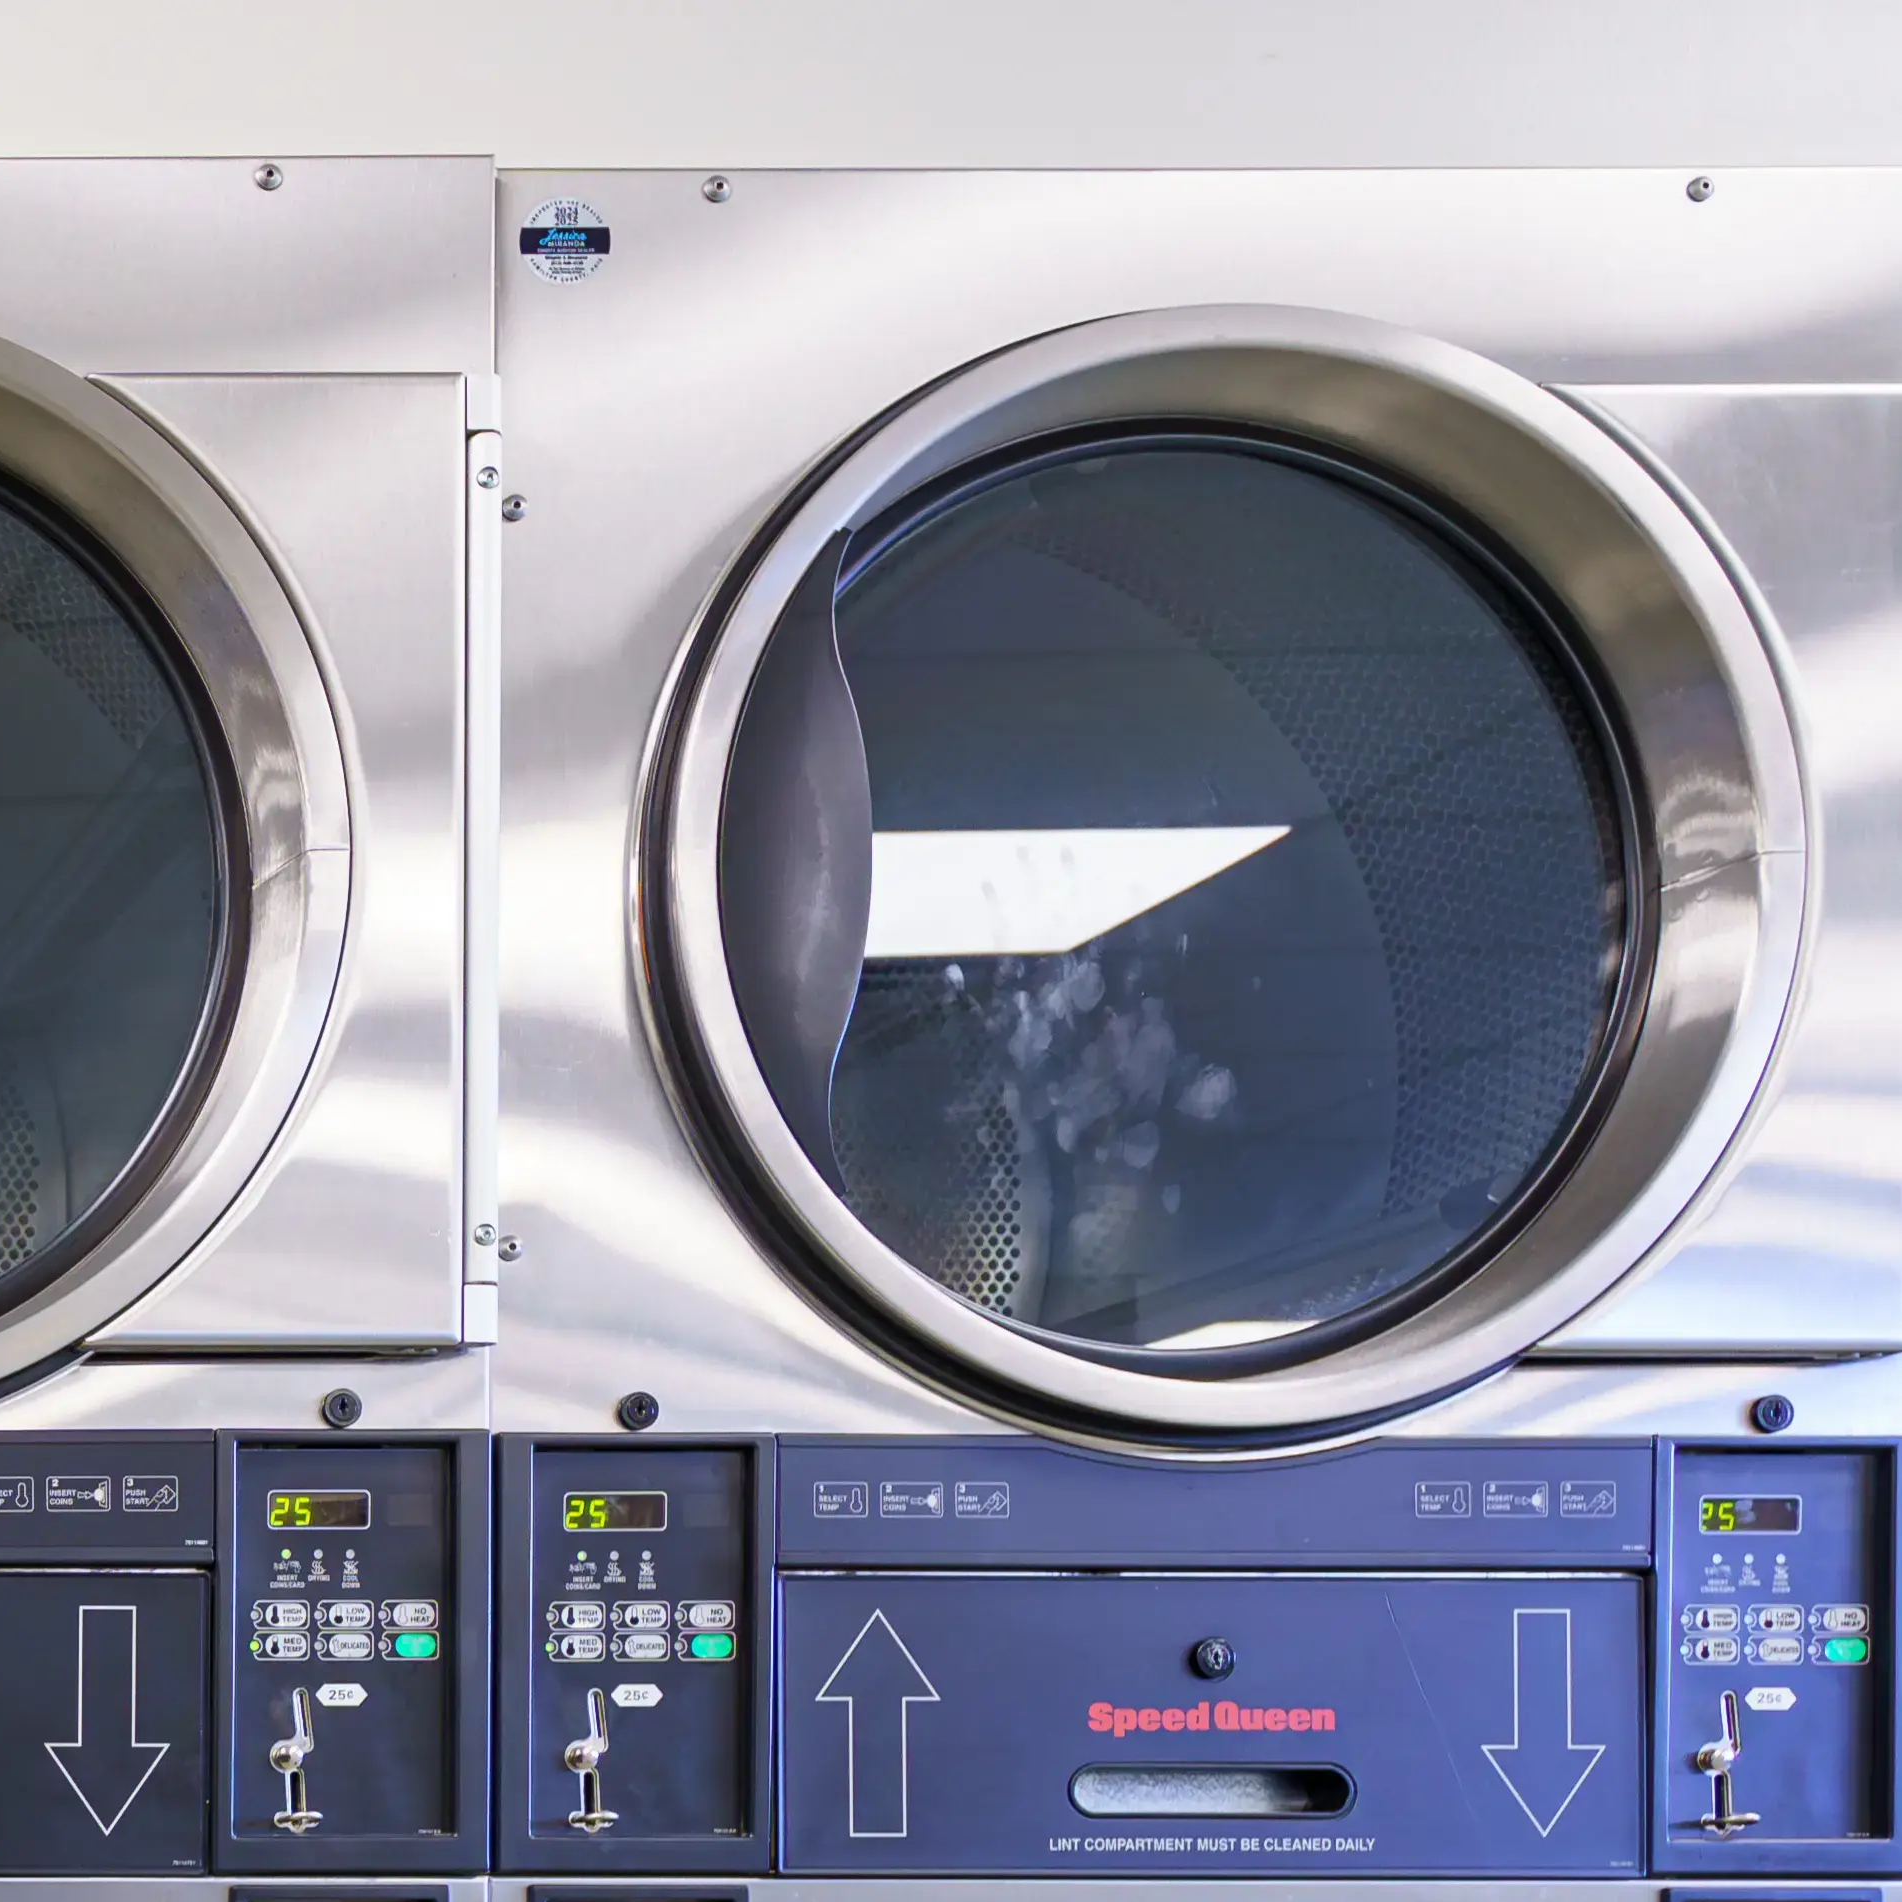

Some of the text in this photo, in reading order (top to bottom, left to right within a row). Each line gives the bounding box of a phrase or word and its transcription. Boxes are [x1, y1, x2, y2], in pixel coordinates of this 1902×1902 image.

[271, 1498, 311, 1525] 25
[566, 1500, 606, 1528] 25
[1088, 1702, 1335, 1737] Speed Queen
[1050, 1838, 1375, 1852] LINT COMPARTMENT MUST BE CLEANED DAILY
